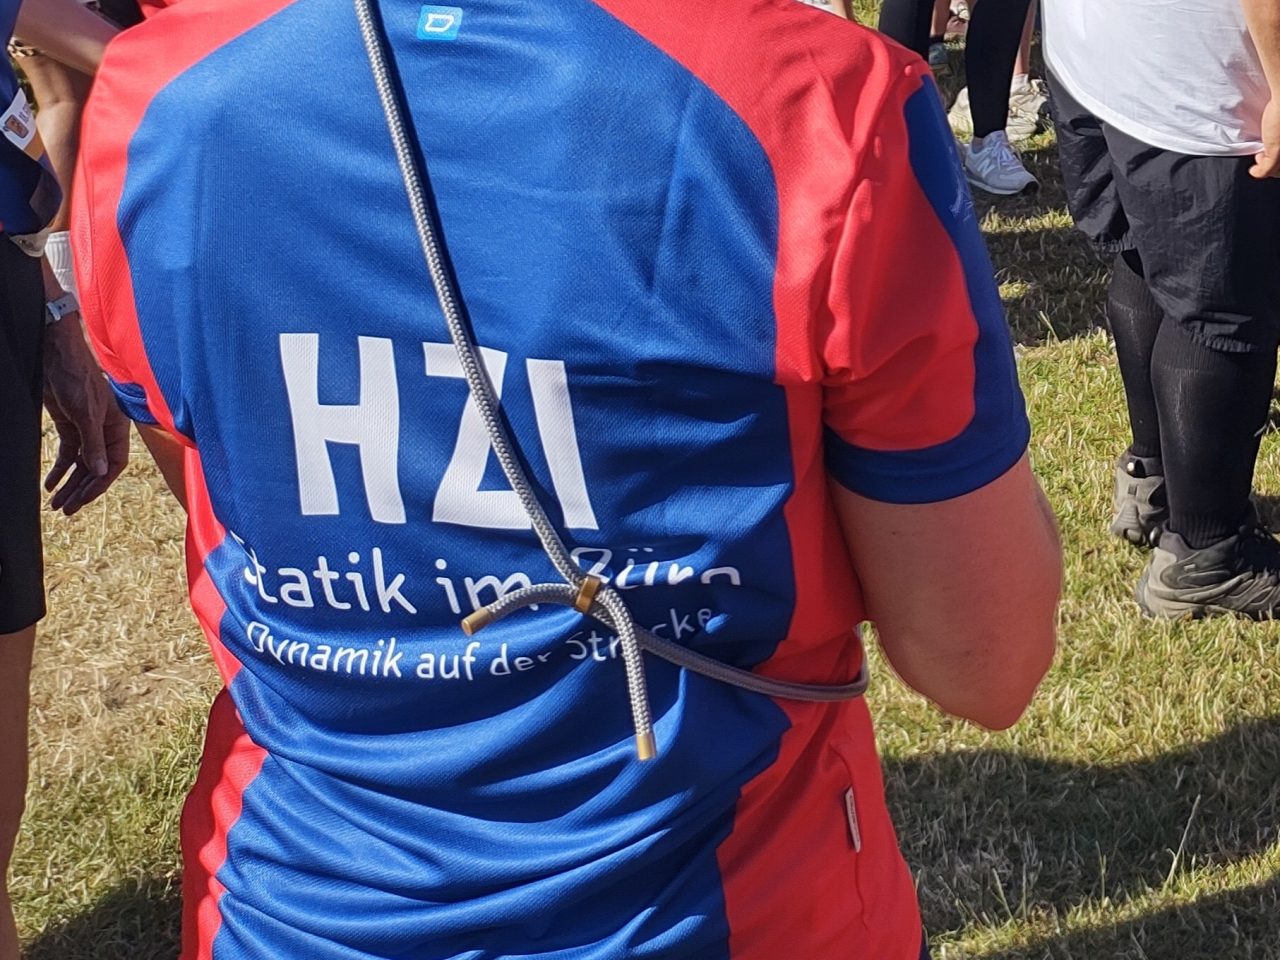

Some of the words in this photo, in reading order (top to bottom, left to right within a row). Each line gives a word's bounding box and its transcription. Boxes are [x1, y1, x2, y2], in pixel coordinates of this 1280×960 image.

[279, 332, 599, 531] HZI
[247, 621, 402, 678] Dynamik
[417, 642, 481, 681] auf
[490, 643, 552, 676] der
